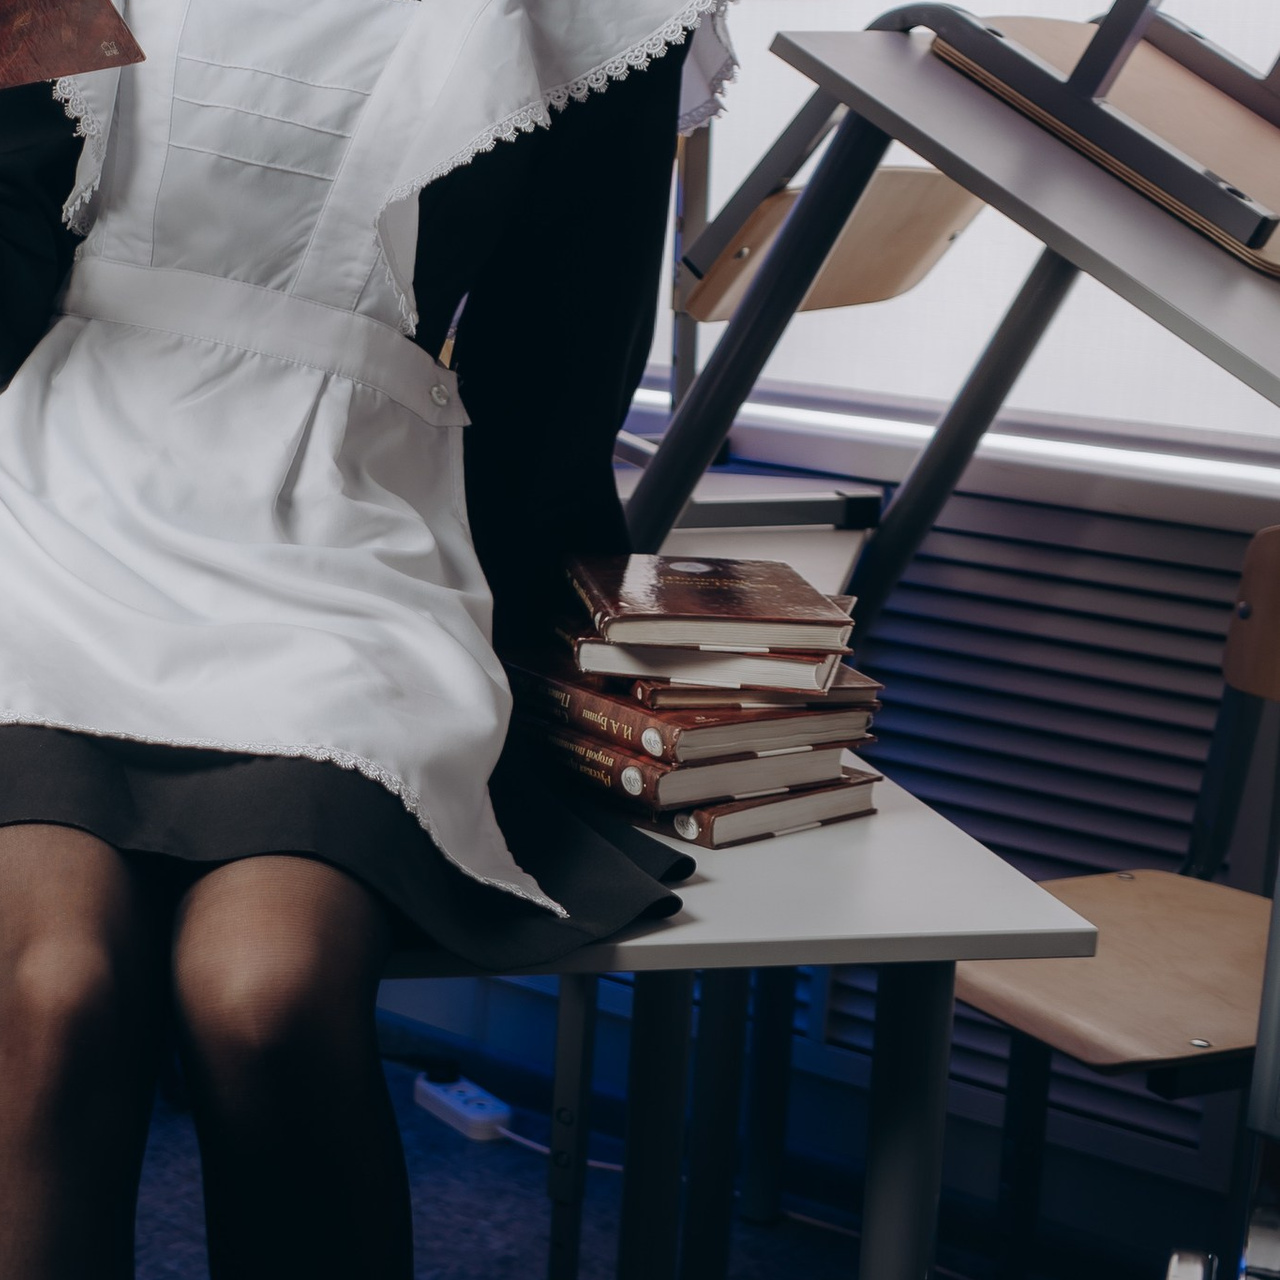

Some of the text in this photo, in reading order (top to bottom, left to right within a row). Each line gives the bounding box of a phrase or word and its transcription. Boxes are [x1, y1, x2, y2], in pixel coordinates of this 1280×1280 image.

[582, 709, 608, 731] Бунин
[609, 719, 620, 734] А.
[622, 723, 633, 741] И.
[586, 748, 615, 767] второй
